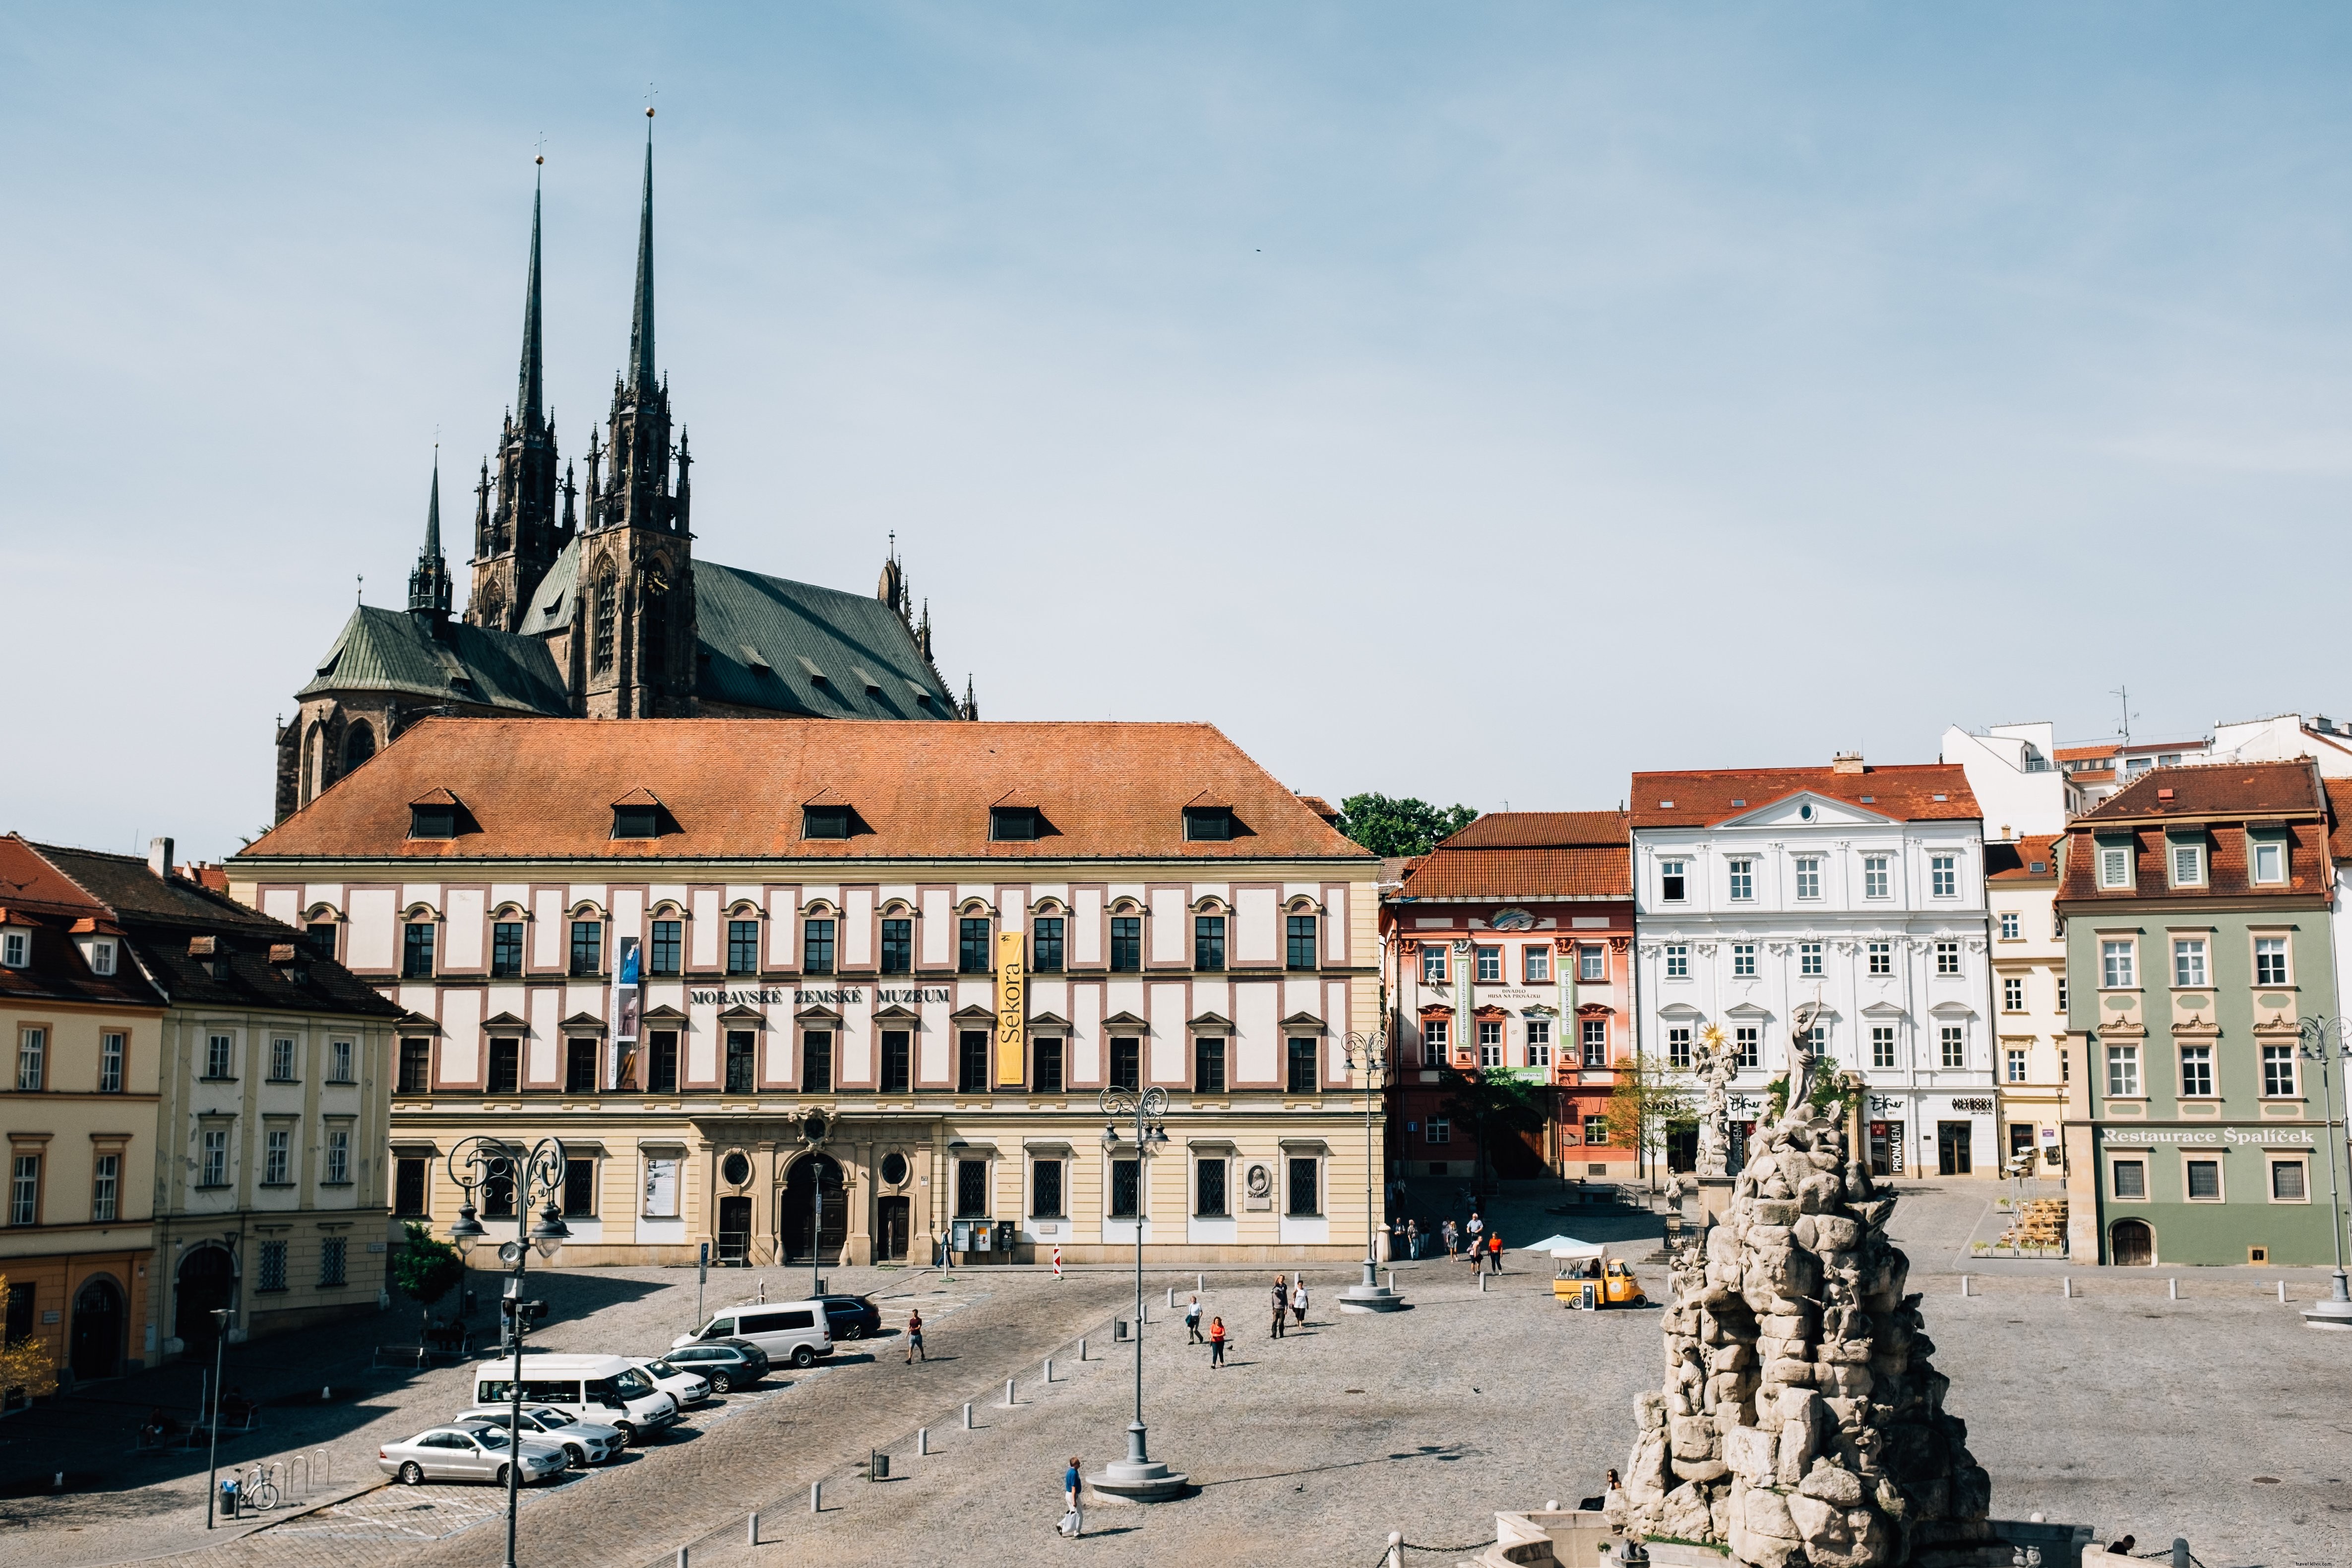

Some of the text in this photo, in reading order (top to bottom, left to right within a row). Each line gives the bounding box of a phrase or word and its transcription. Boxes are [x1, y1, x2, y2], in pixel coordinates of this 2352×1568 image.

[690, 986, 950, 1004] MORAVSKÉ ZEMSKÉ MUZEUM
[1000, 963, 1020, 1043] Sekora
[1890, 1125, 1902, 1172] PRONÁJEM
[2101, 1126, 2315, 1145] Restaurace Špalíček
